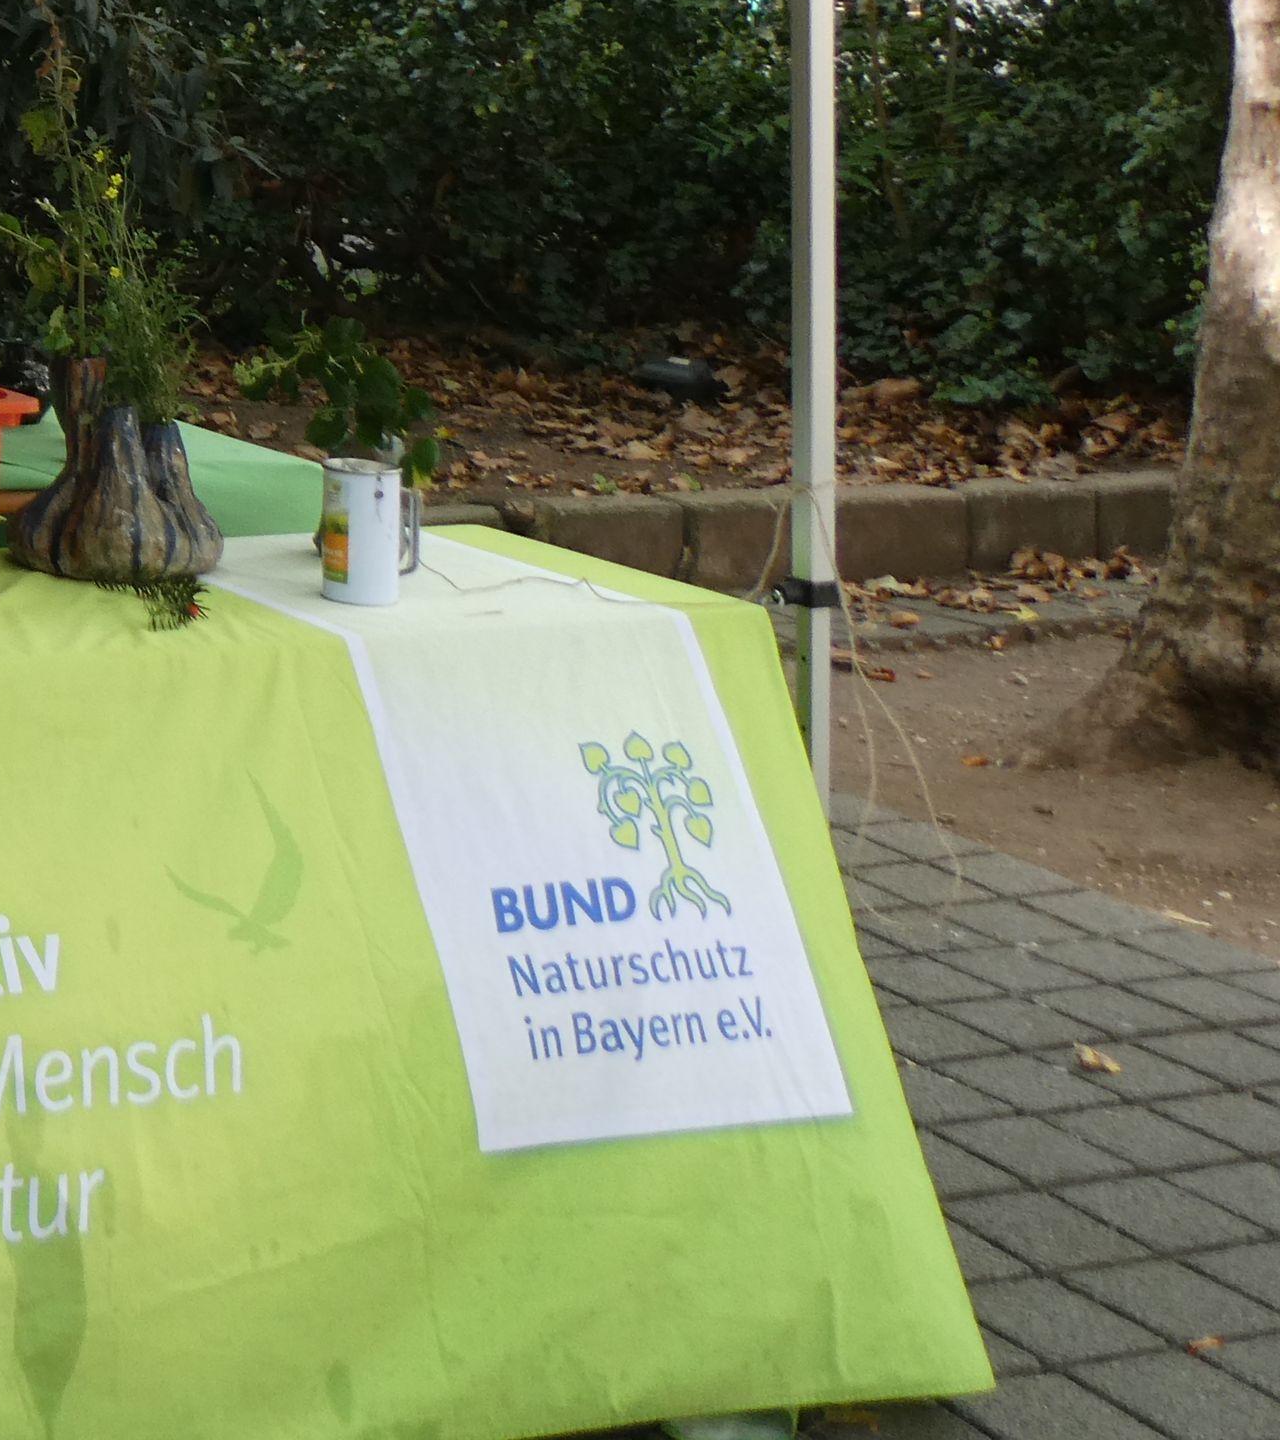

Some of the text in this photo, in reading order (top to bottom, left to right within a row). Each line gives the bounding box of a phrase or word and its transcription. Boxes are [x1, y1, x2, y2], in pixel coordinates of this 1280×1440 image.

[490, 876, 637, 934] BUND
[507, 938, 754, 998] Naturschutz
[523, 995, 773, 1062] in Bayern e.V.
